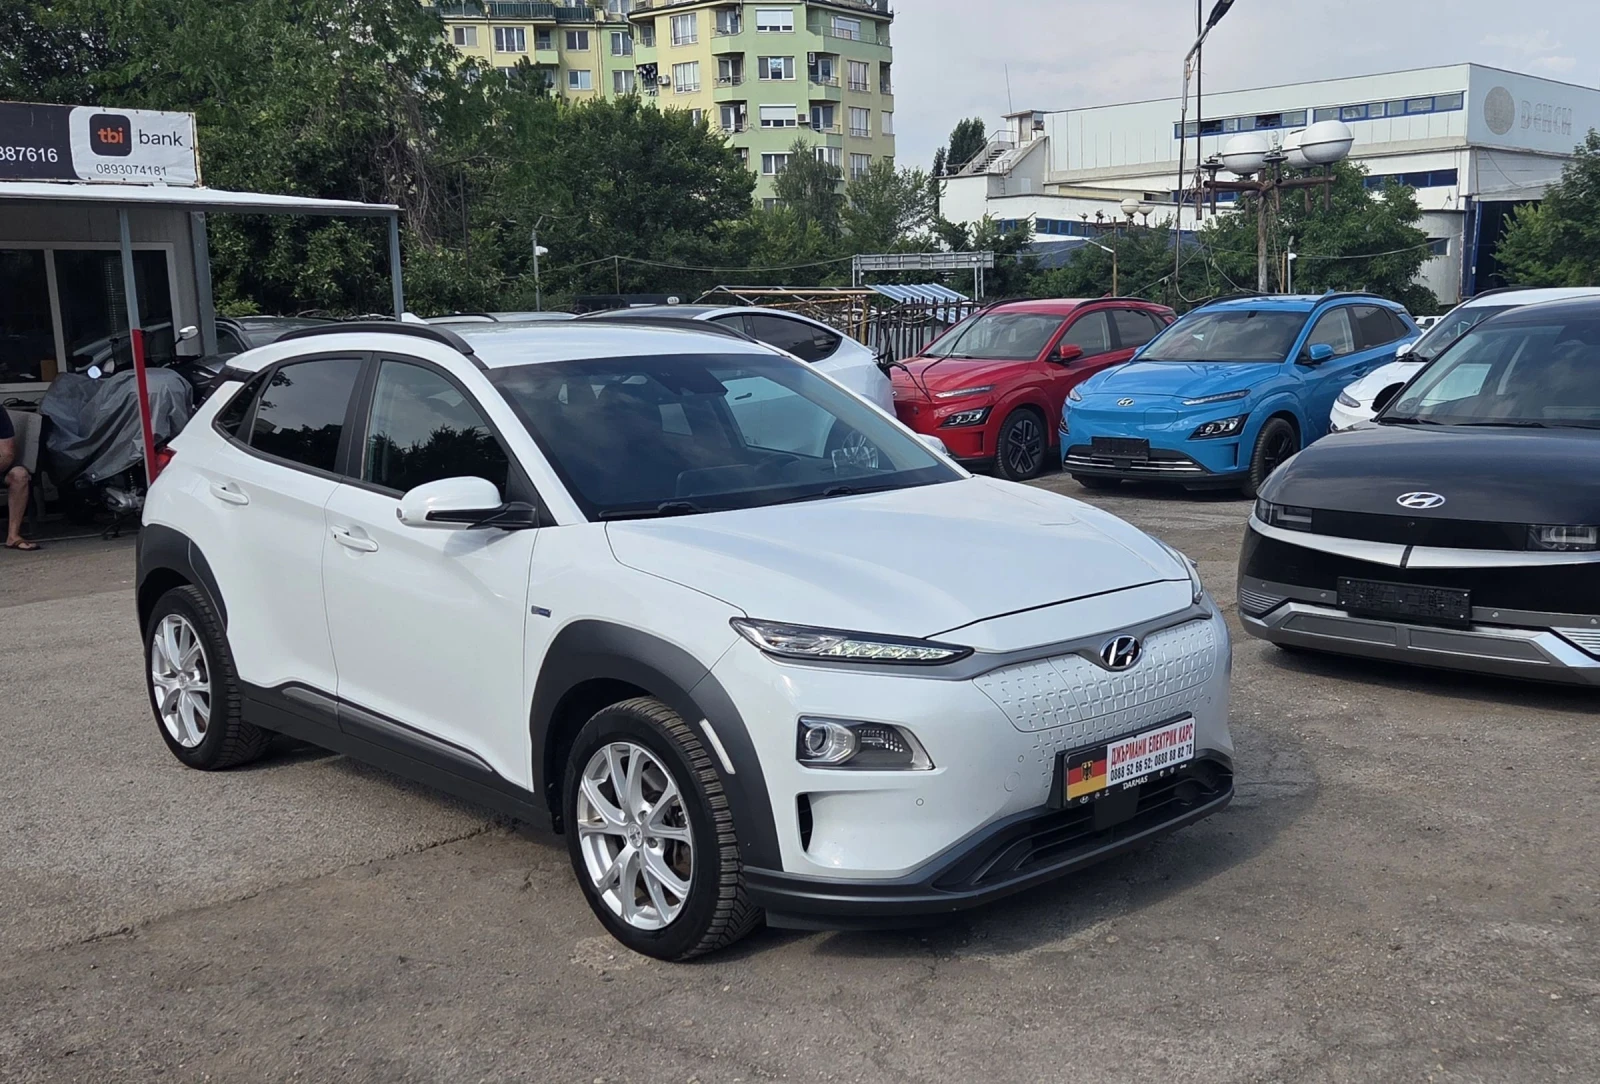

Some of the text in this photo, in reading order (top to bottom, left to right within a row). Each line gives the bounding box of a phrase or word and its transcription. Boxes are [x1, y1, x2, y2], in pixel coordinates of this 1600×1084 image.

[98, 127, 183, 147] tbi bank
[96, 163, 167, 176] 0893074181
[1111, 723, 1193, 767] ДЖЪРМАНИ ЕЛЕКТРИК КАРС
[1126, 763, 1134, 776] 52
[1123, 775, 1148, 790] DARMAS
